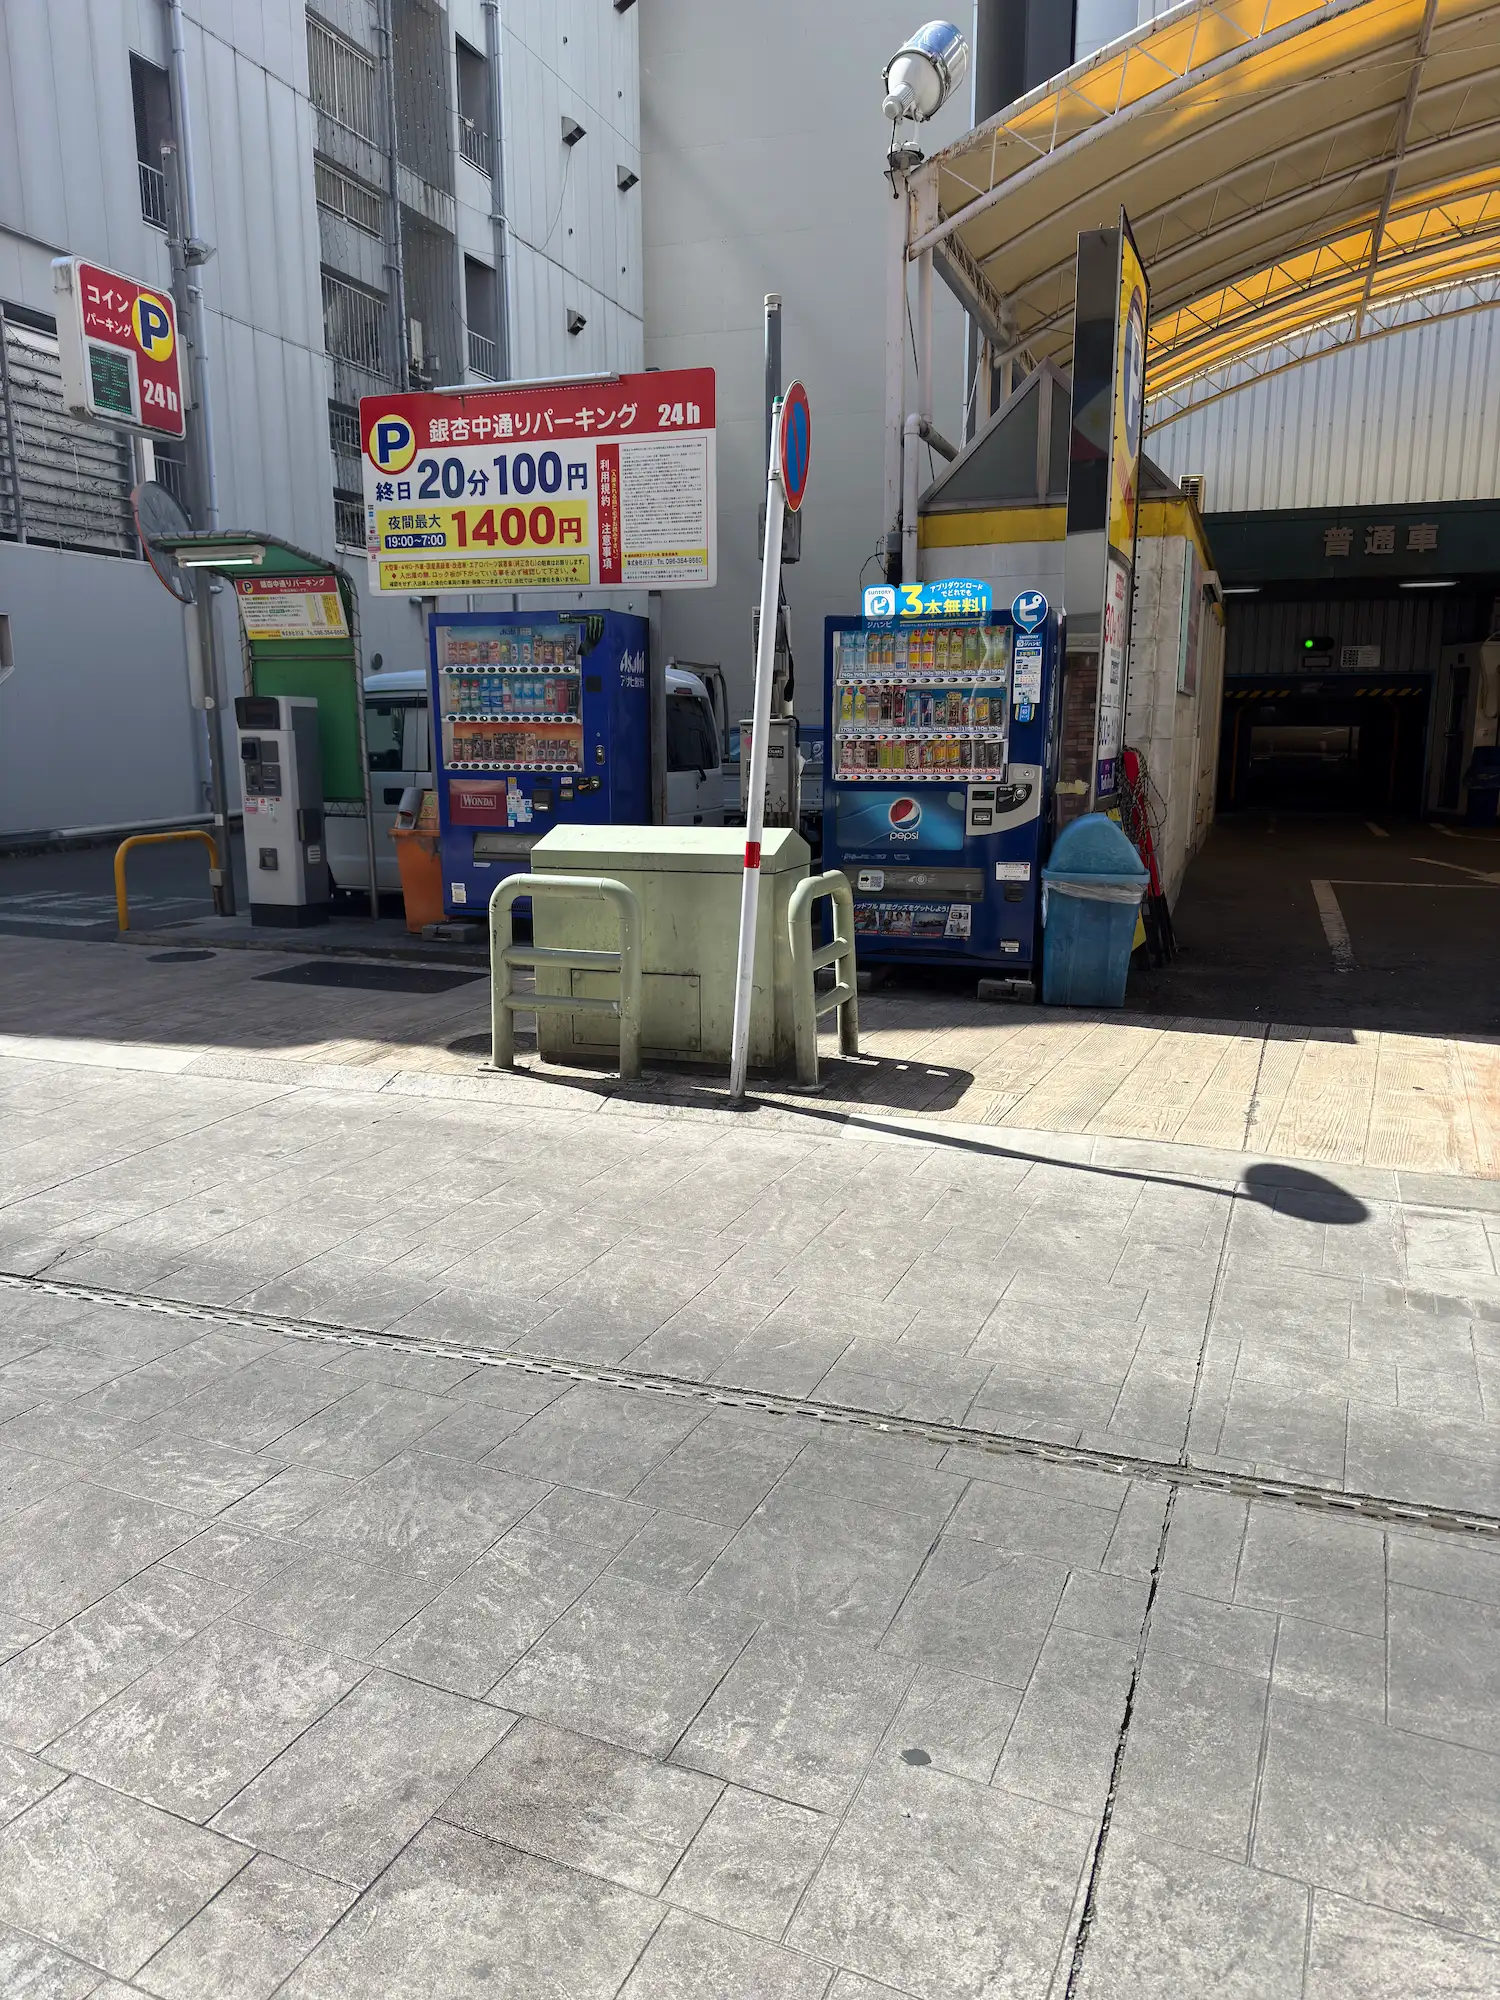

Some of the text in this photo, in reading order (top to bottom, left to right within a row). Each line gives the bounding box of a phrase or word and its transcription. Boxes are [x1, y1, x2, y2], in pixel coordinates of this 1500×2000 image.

[86, 283, 130, 313] コイン
[85, 313, 133, 339] パーキング
[137, 300, 170, 350] P
[142, 378, 179, 412] 24h
[428, 402, 701, 444] 銀杏中通りパーキング 24h
[376, 422, 410, 464] P
[388, 514, 442, 531] 夜間最大
[451, 506, 582, 547] 1400円
[1323, 523, 1439, 557] 普通車
[243, 582, 252, 592] P
[929, 581, 984, 594] アプリダウンロード
[940, 589, 972, 598] でどれでも
[1019, 594, 1043, 622] ピ
[620, 648, 645, 674] Asahi
[620, 675, 645, 688] アサヒ飲料
[462, 795, 494, 806] WONDA
[889, 831, 920, 842] pepsi
